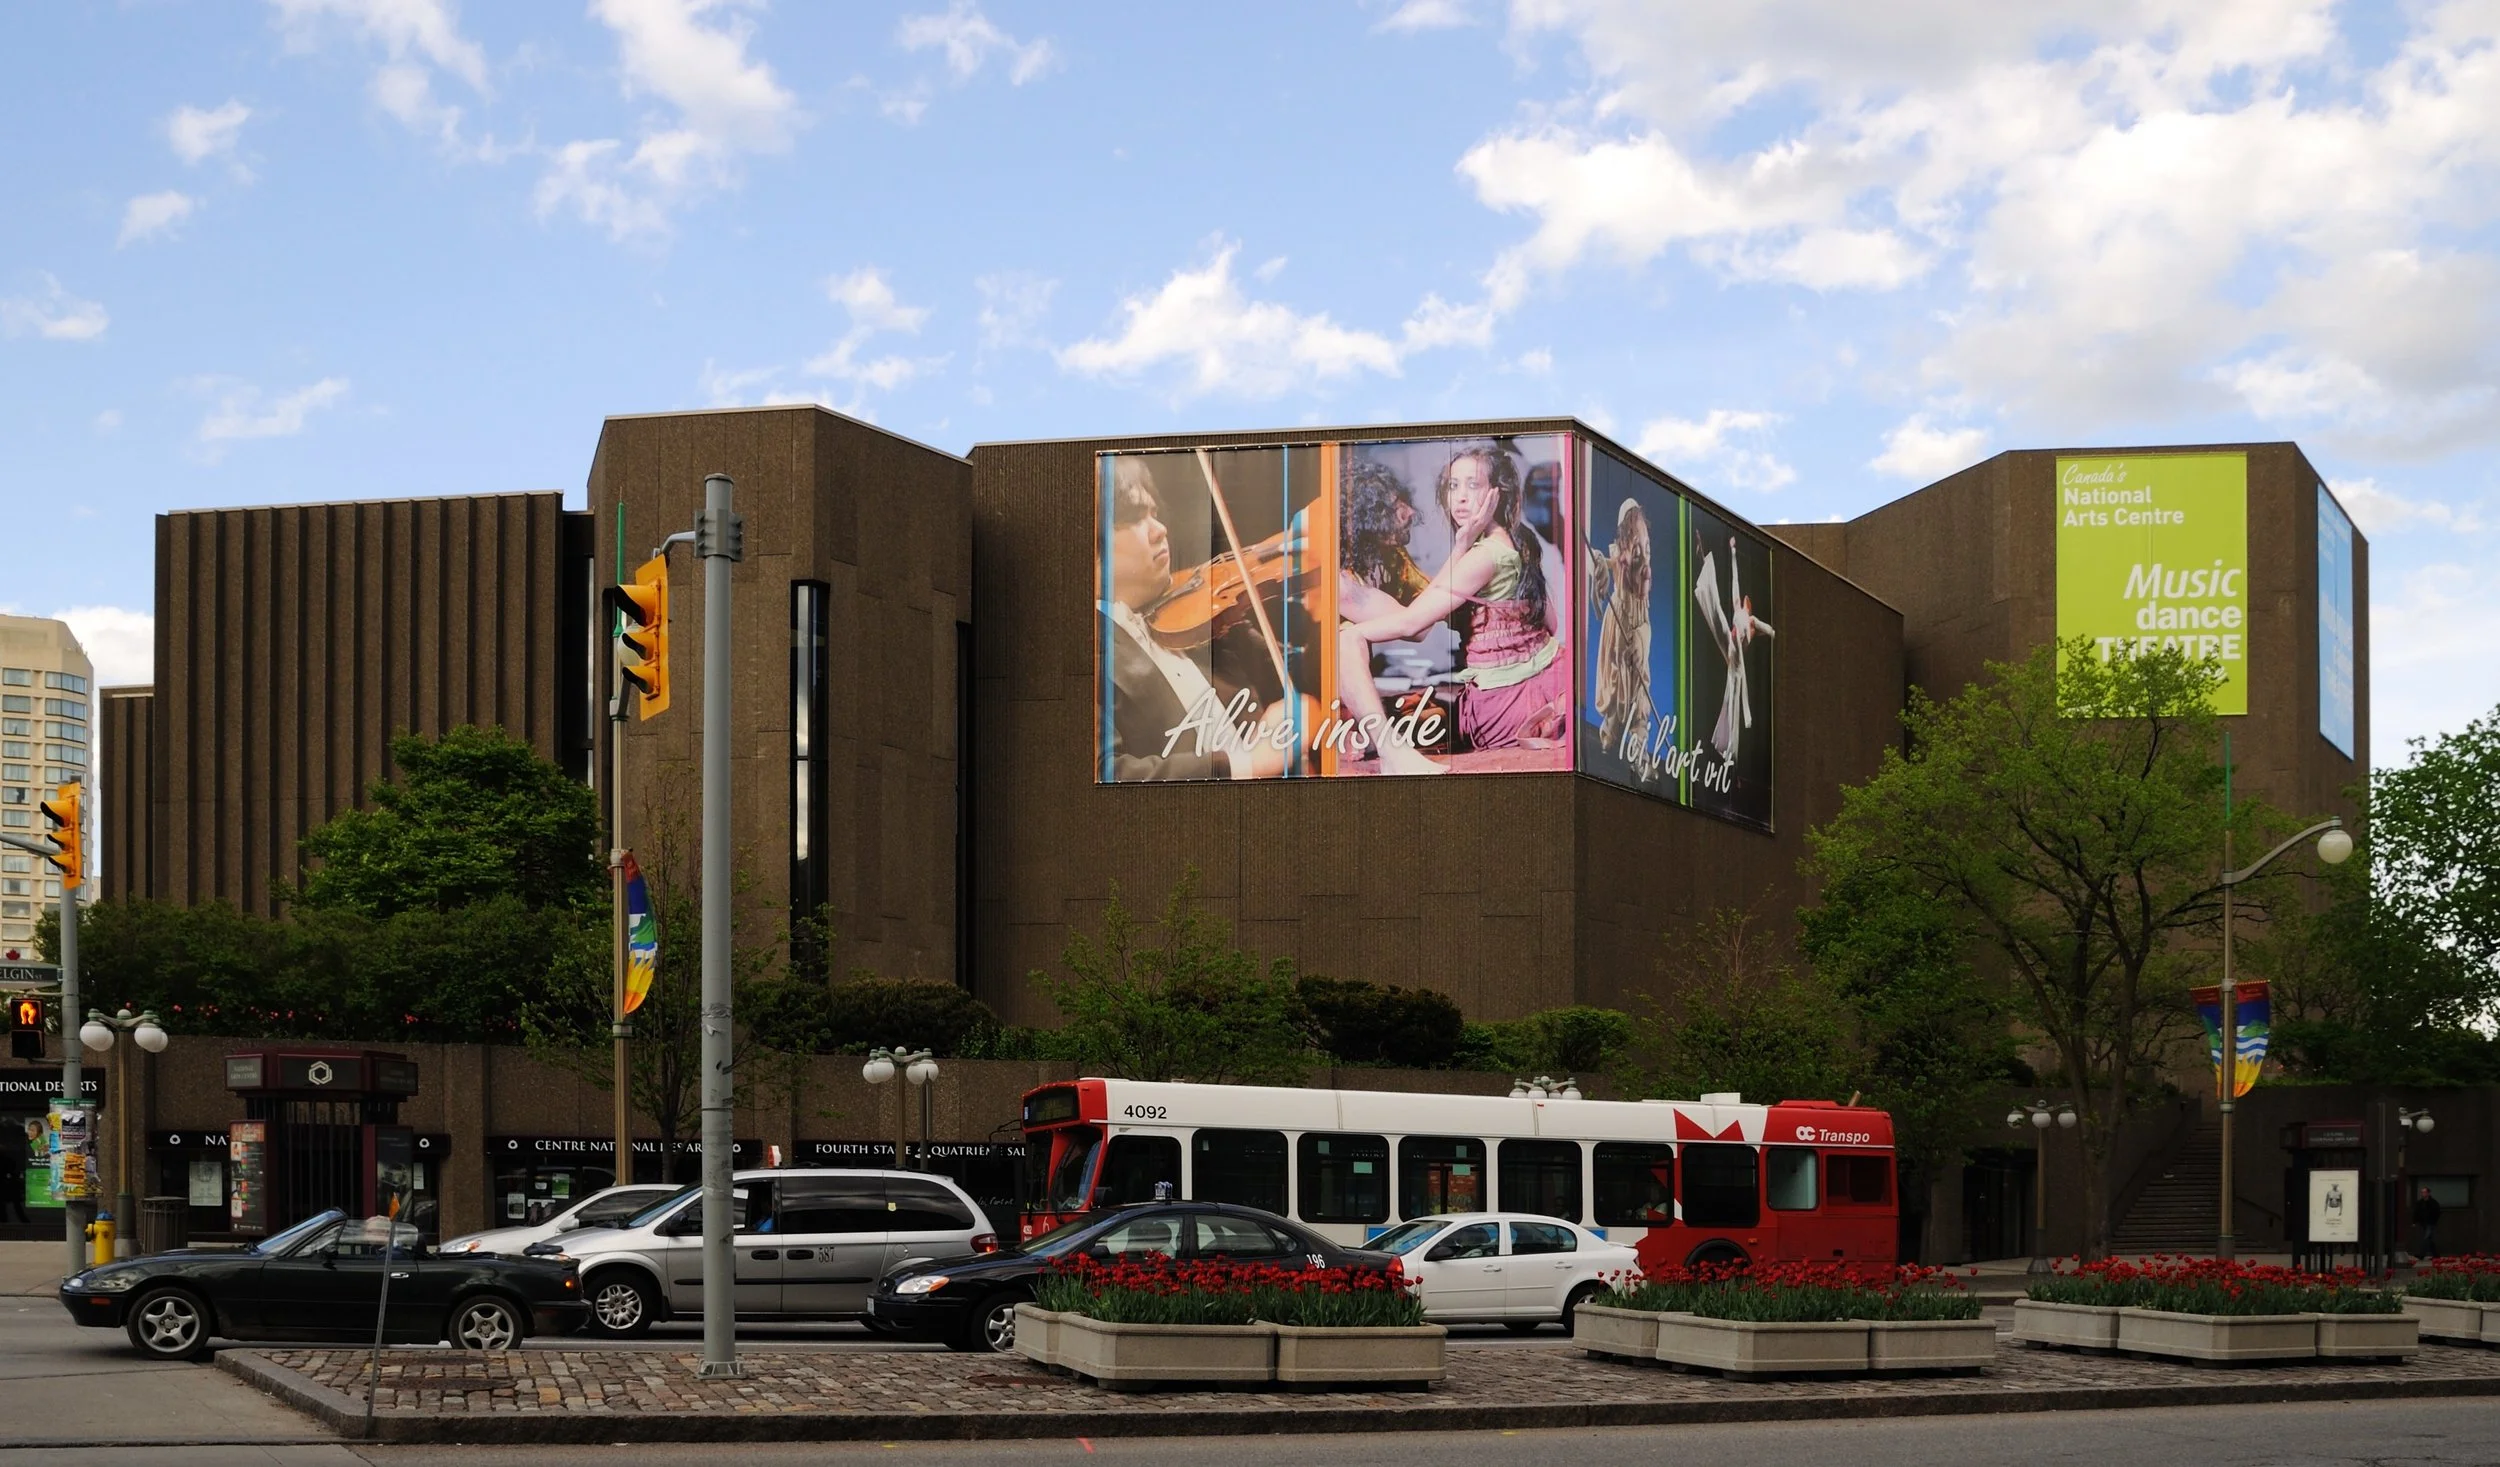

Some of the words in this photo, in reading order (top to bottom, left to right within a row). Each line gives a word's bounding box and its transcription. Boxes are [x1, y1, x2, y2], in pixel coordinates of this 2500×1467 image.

[2063, 463, 2128, 485] Canada's
[2063, 486, 2153, 506] National
[2063, 509, 2108, 527] Arts
[2114, 508, 2185, 526] Centre
[2123, 559, 2241, 600] Music
[2136, 601, 2242, 630] dance
[1161, 687, 1299, 758] Alive
[1312, 685, 1446, 754] inside
[1652, 714, 1704, 783] l'art
[1704, 750, 1735, 794] vit
[1124, 1104, 1167, 1119] 4092
[535, 1140, 586, 1151] CENTRE
[590, 1141, 656, 1152] NATNAL
[1819, 1128, 1870, 1145] Transpo
[816, 1144, 868, 1154] FOURTH
[873, 1144, 911, 1155] STAE
[931, 1144, 1003, 1158] QUATRIÈM
[819, 1246, 835, 1263] 587
[1306, 1253, 1326, 1269] 196
